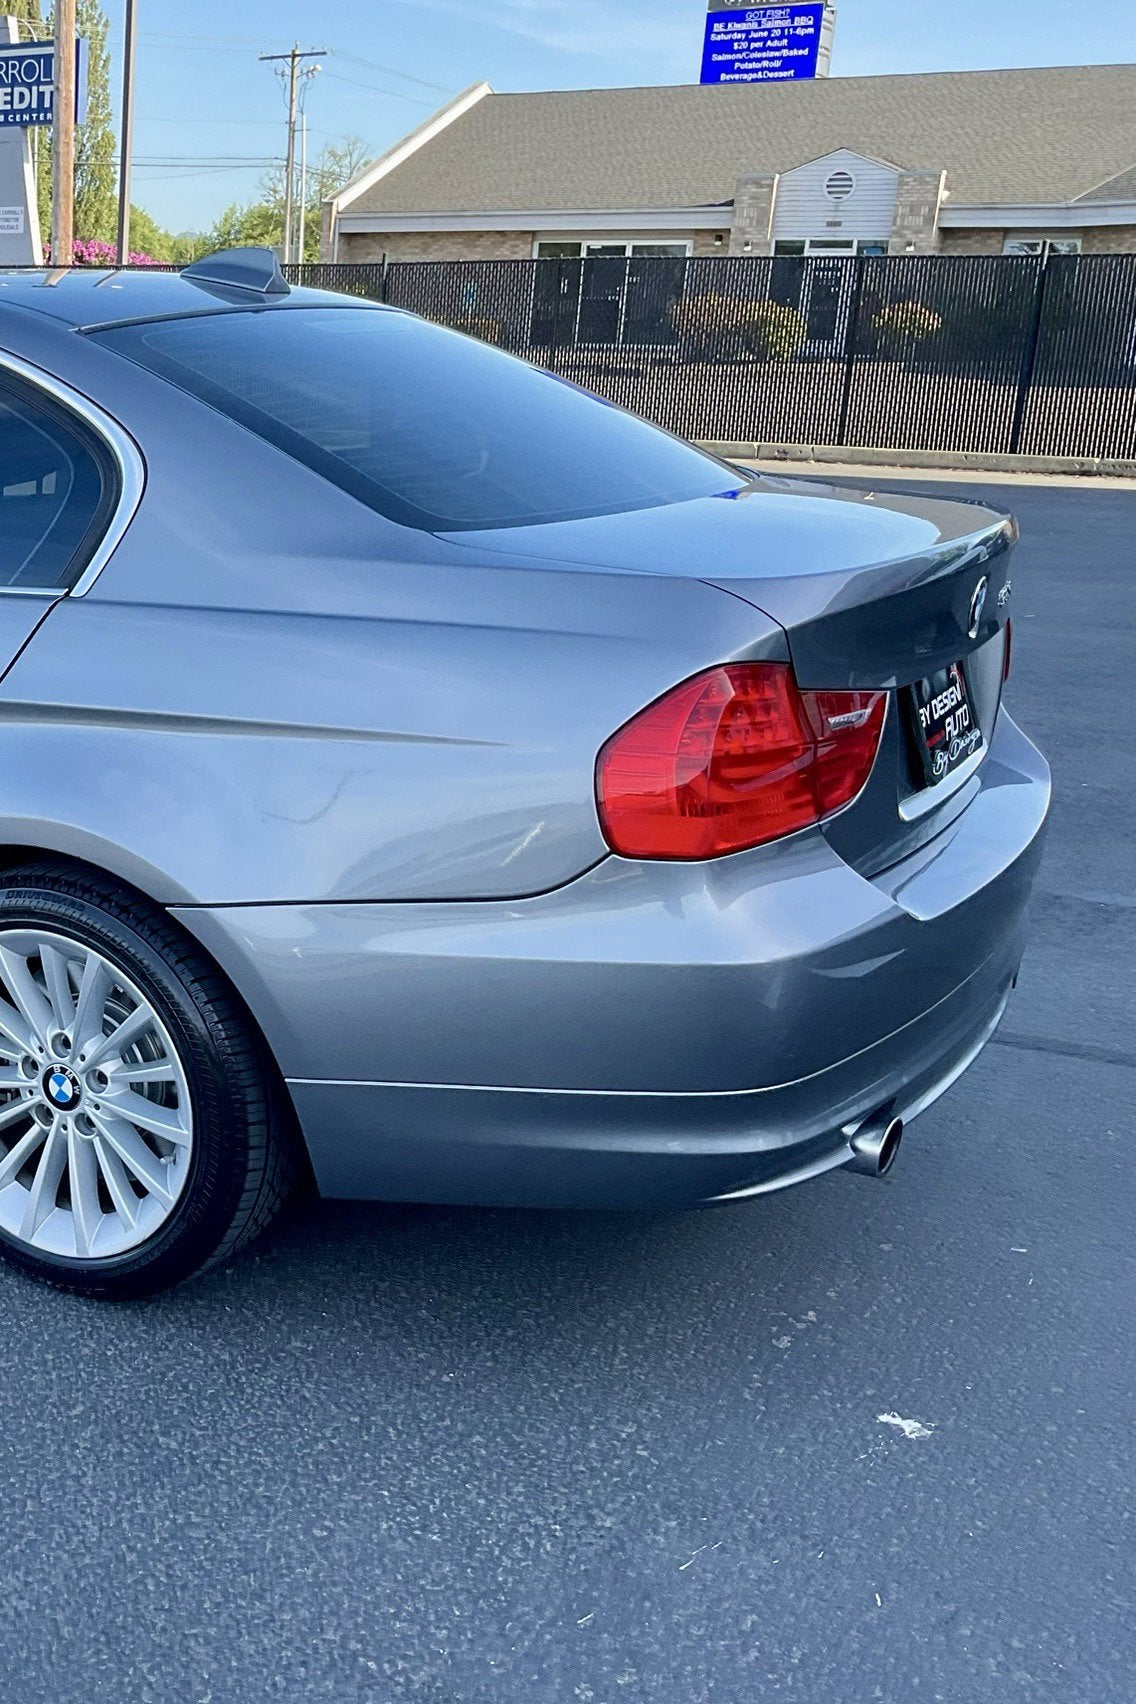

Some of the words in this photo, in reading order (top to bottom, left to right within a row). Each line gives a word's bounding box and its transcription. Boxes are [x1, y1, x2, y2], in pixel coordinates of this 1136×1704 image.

[745, 11, 765, 21] GOT
[766, 9, 790, 19] FISH?
[760, 18, 791, 28] Salmon
[794, 16, 814, 26] BBQ
[710, 31, 746, 41] Saturday
[748, 30, 768, 39] June
[771, 28, 781, 37] 20
[733, 41, 749, 50] $20
[750, 41, 763, 50] per
[766, 39, 788, 48] Adult
[711, 48, 809, 61] Salmon/Coleslaw/Baked
[720, 70, 794, 81] Beverage&Dessert
[7, 113, 53, 122] CENTER
[931, 683, 962, 721] DESIGN
[945, 703, 970, 741] AUTO
[932, 749, 949, 778] By
[948, 728, 981, 761] Design
[53, 1065, 81, 1095] BMW
